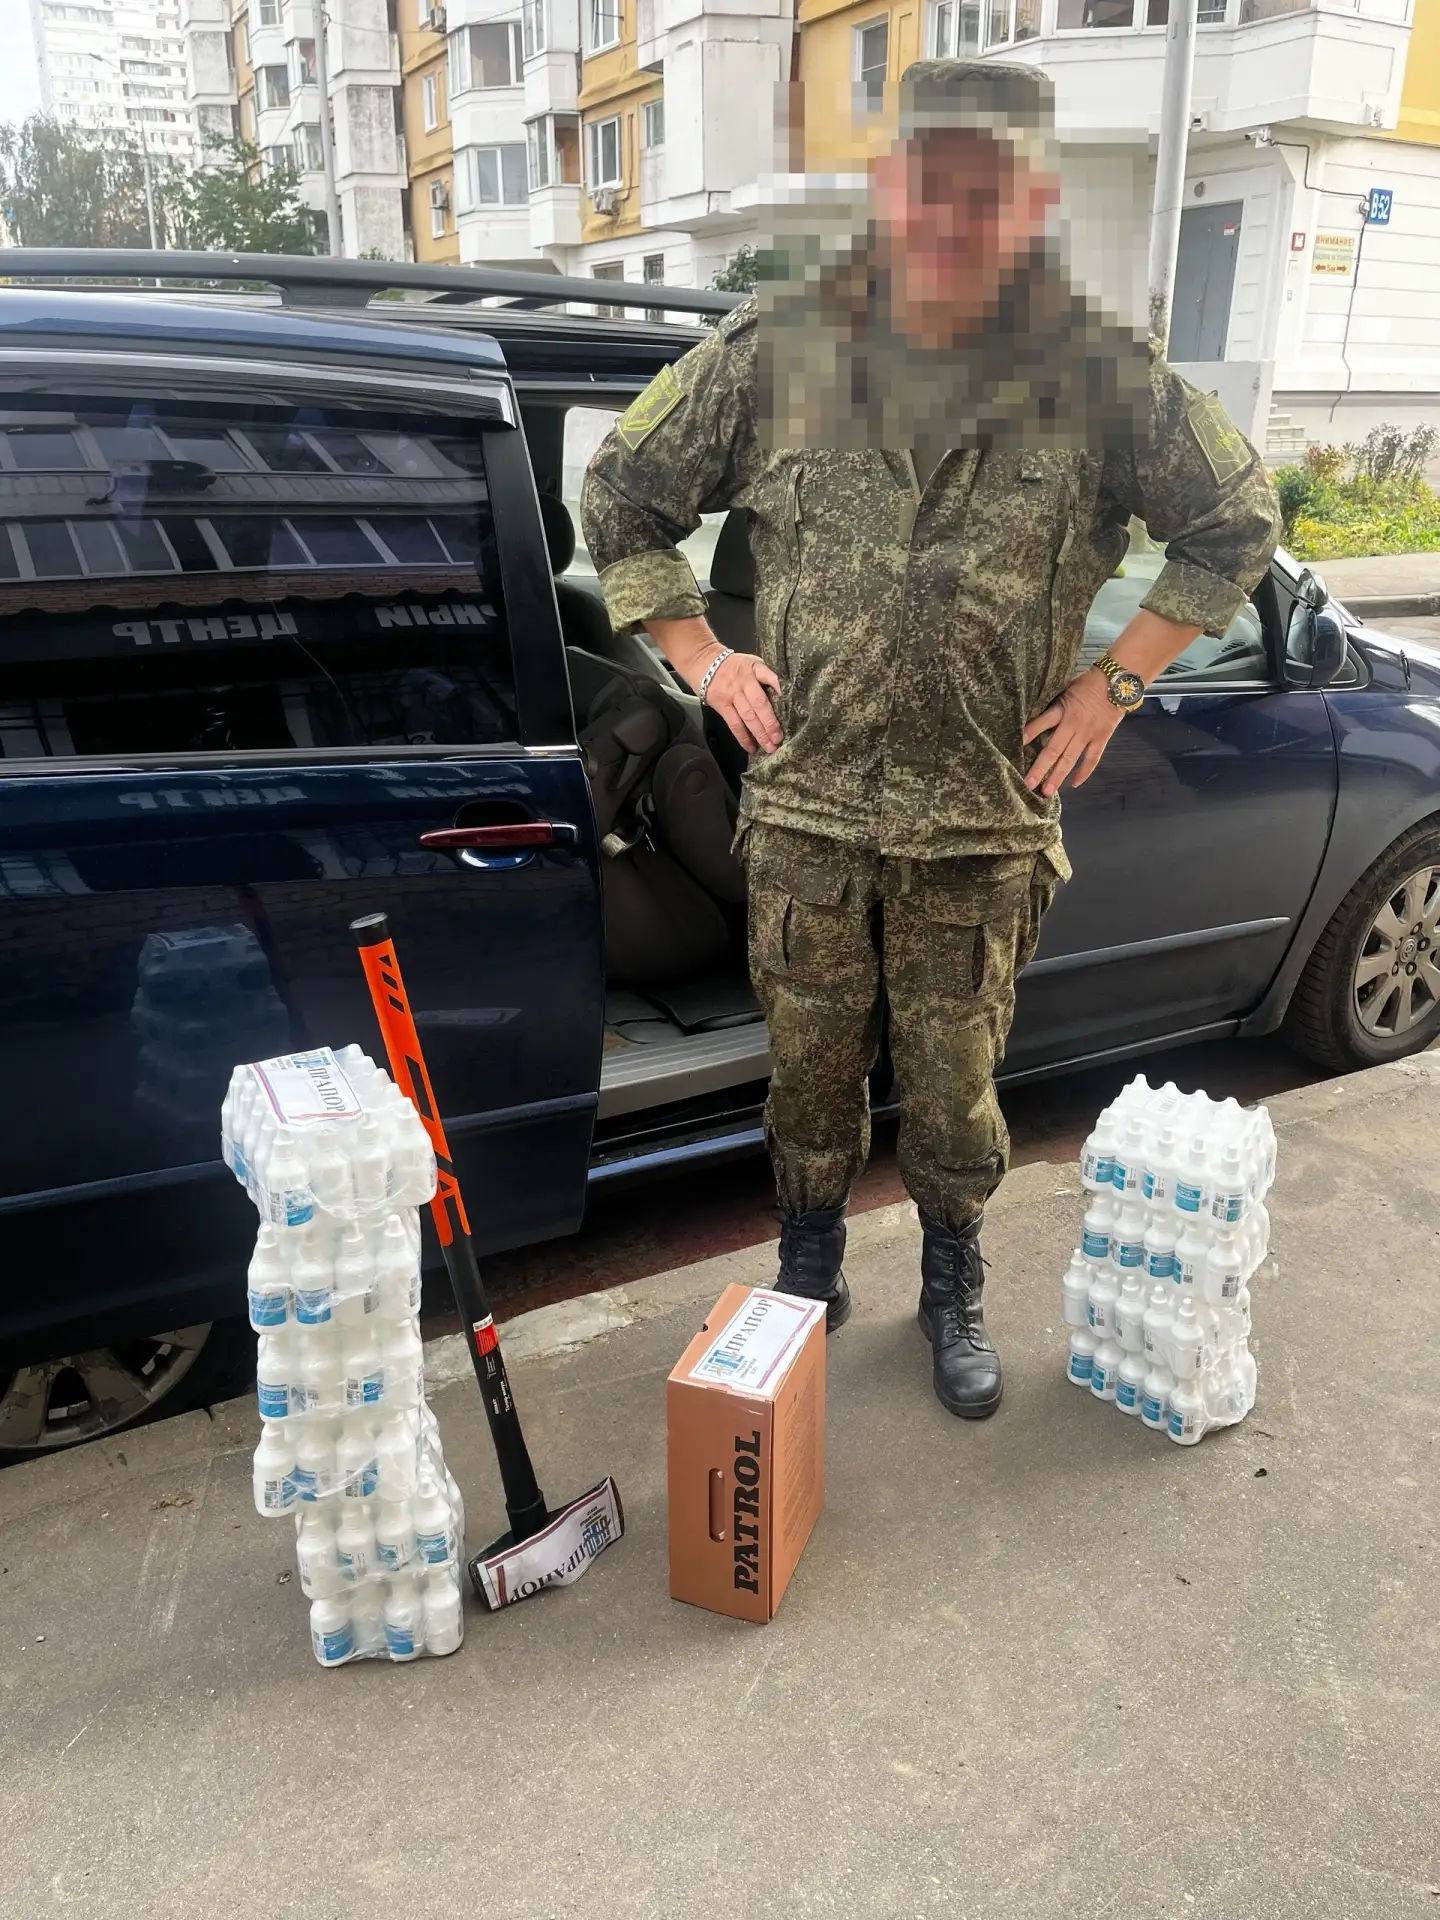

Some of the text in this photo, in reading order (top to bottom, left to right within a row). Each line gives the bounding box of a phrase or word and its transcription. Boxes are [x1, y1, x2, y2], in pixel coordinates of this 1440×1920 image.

[308, 1067, 346, 1112] ПРАПОР
[724, 1299, 773, 1352] ПРАПОР
[733, 1430, 761, 1595] PATROL
